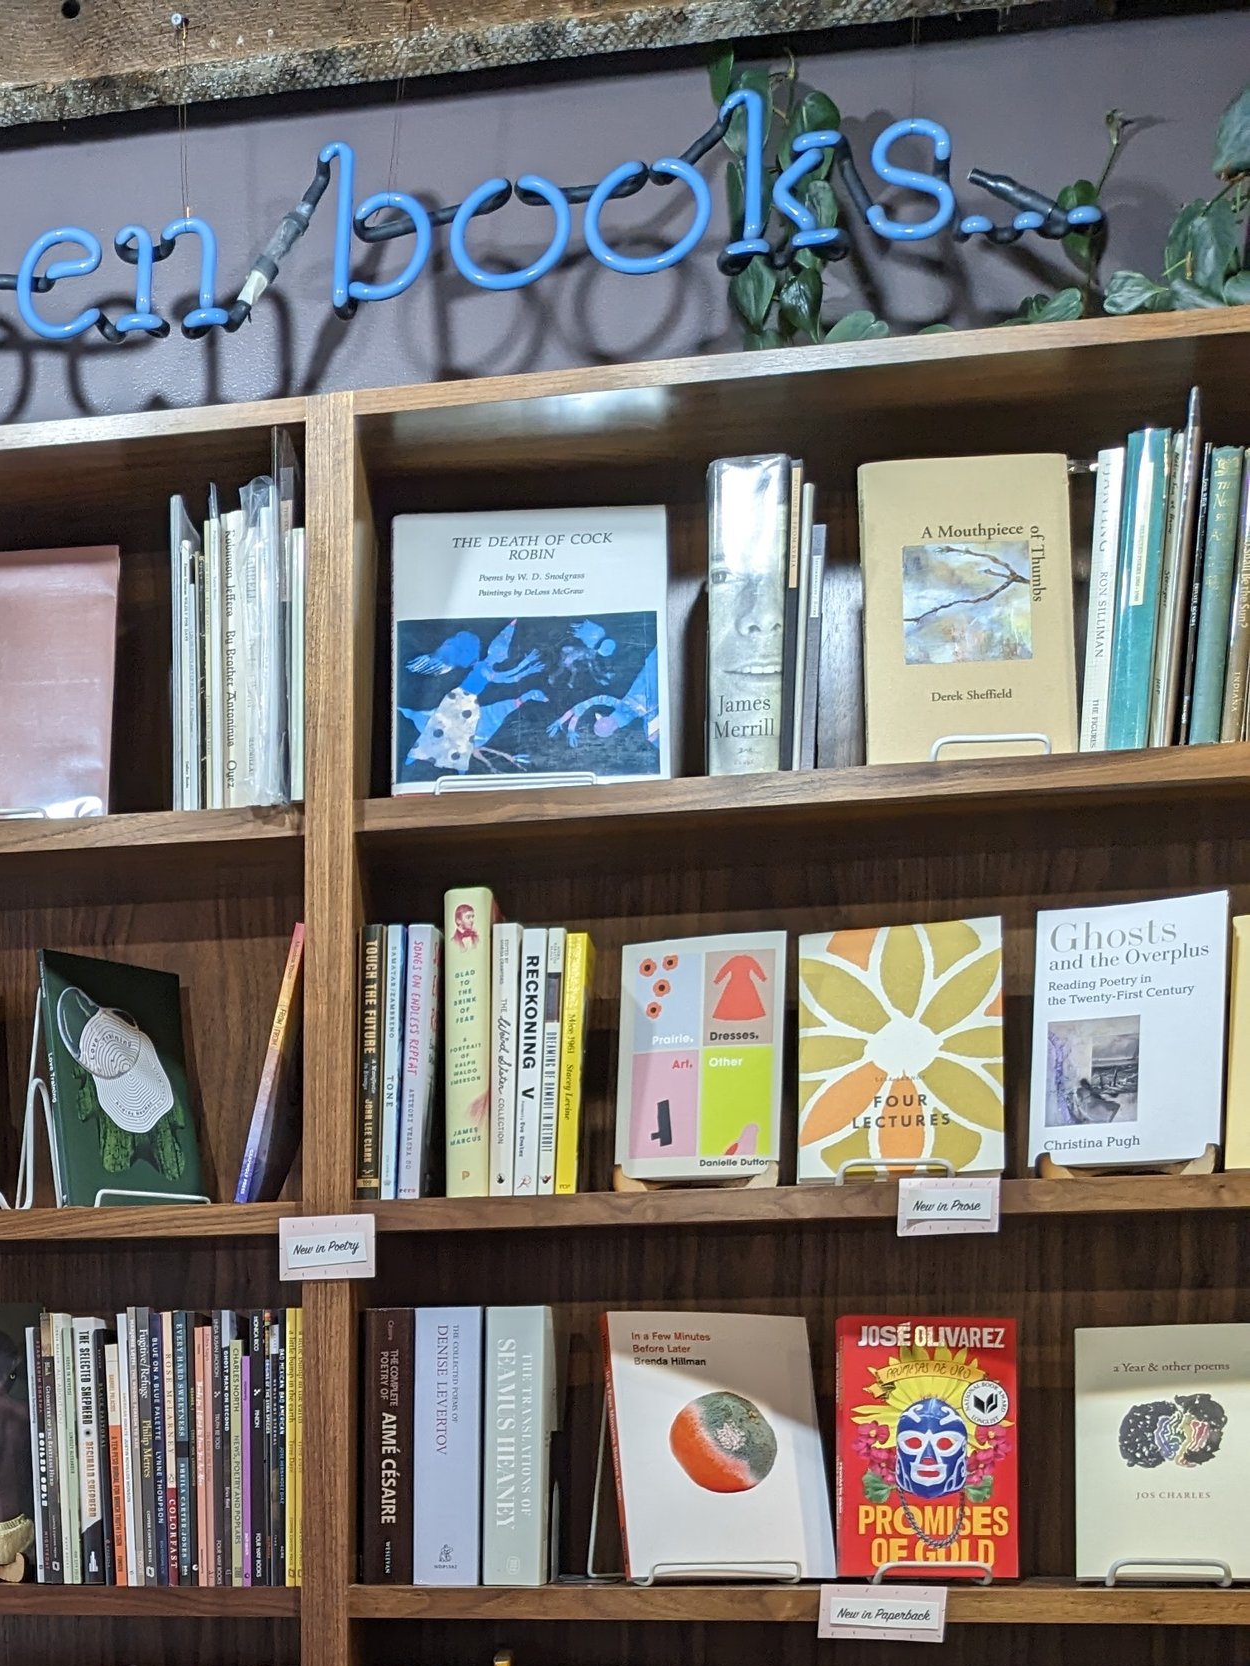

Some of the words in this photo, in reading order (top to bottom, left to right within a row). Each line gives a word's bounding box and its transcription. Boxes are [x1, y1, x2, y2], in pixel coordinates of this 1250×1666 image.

[452, 536, 482, 548] THE
[488, 535, 539, 548] DEATH
[544, 534, 564, 546] OF
[570, 533, 613, 545] COCK
[921, 526, 933, 537] A
[938, 523, 1024, 540] Mouthpiece
[1029, 525, 1043, 540] of
[508, 548, 554, 560] ROBIN
[479, 573, 503, 582] Poems
[506, 573, 515, 583] by
[517, 573, 529, 581] W.
[532, 572, 542, 581] D.
[545, 571, 585, 582] Snodgrass
[1029, 543, 1046, 603] Thumbs
[931, 690, 963, 702] Derek
[966, 688, 1012, 701] Sheffield
[718, 696, 771, 715] James
[714, 720, 775, 739] Merrill
[1050, 920, 1177, 953] Ghosts
[367, 940, 378, 976] TOUCH
[1049, 955, 1083, 971] and
[1091, 953, 1120, 968] the
[1126, 943, 1209, 965] Overplus
[366, 980, 376, 1003] THE
[522, 955, 539, 1069] RECKONING
[364, 1006, 376, 1054] FUTURE
[709, 1056, 742, 1067] Other
[874, 1095, 928, 1108] FOUR
[853, 1113, 951, 1129] LECTURES
[1044, 1138, 1102, 1151] Christina
[1106, 1136, 1141, 1151] Pugh
[700, 1159, 736, 1167] Danielle
[913, 1200, 934, 1211] New
[937, 1201, 948, 1211] in
[951, 1200, 981, 1211] Prose
[293, 1243, 313, 1256] New
[316, 1245, 325, 1254] in
[328, 1238, 360, 1256] Poetry
[858, 1323, 910, 1348] JOSÉ
[914, 1325, 1005, 1348] OLIVAREZ
[633, 1344, 663, 1354] Before
[666, 1344, 691, 1354] Later
[634, 1357, 668, 1366] Brenda
[671, 1357, 706, 1366] Hillman
[497, 1339, 517, 1432] SEAMUS
[382, 1412, 400, 1455] AIMÉ
[381, 1459, 400, 1524] CÉSAIRE
[496, 1436, 517, 1530] HEANEY
[858, 1505, 1008, 1536] PROMISES
[837, 1607, 858, 1620] New
[861, 1608, 872, 1619] in
[874, 1608, 930, 1621] Paperback
